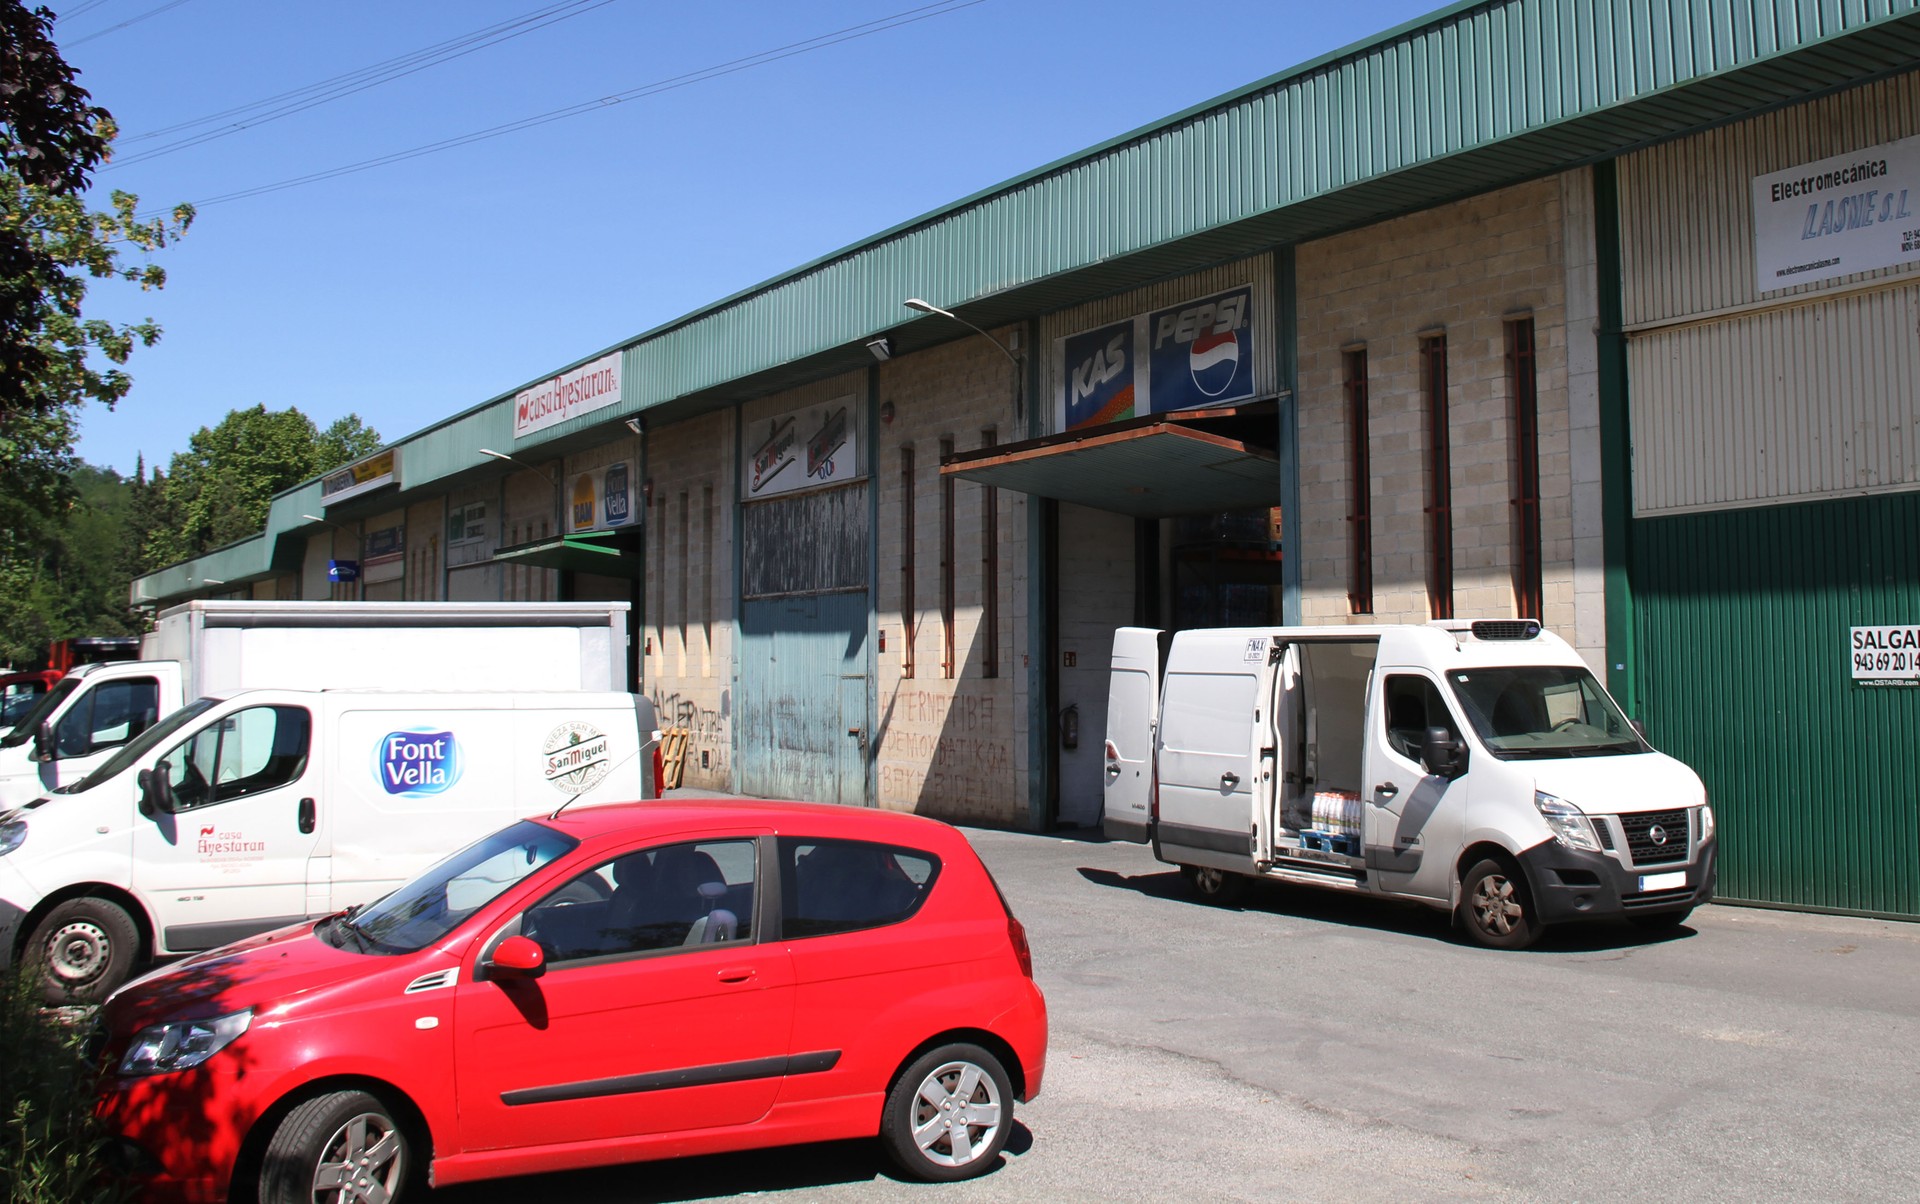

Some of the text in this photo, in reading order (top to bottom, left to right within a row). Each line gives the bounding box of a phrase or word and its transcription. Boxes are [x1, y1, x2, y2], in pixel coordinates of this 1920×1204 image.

[1771, 159, 1887, 202] Electromecánica
[1154, 294, 1248, 350] PEPSI
[1071, 332, 1127, 407] KAS
[529, 391, 552, 422] casa
[553, 367, 612, 418] Ayestaran
[606, 493, 627, 516] Vella
[1854, 652, 1874, 671] 943
[1876, 652, 1890, 671] 69
[1891, 652, 1906, 671] 20
[389, 737, 446, 761] Font
[386, 761, 446, 785] Vella
[218, 832, 242, 840] casa
[197, 840, 265, 857] Ayestaran
